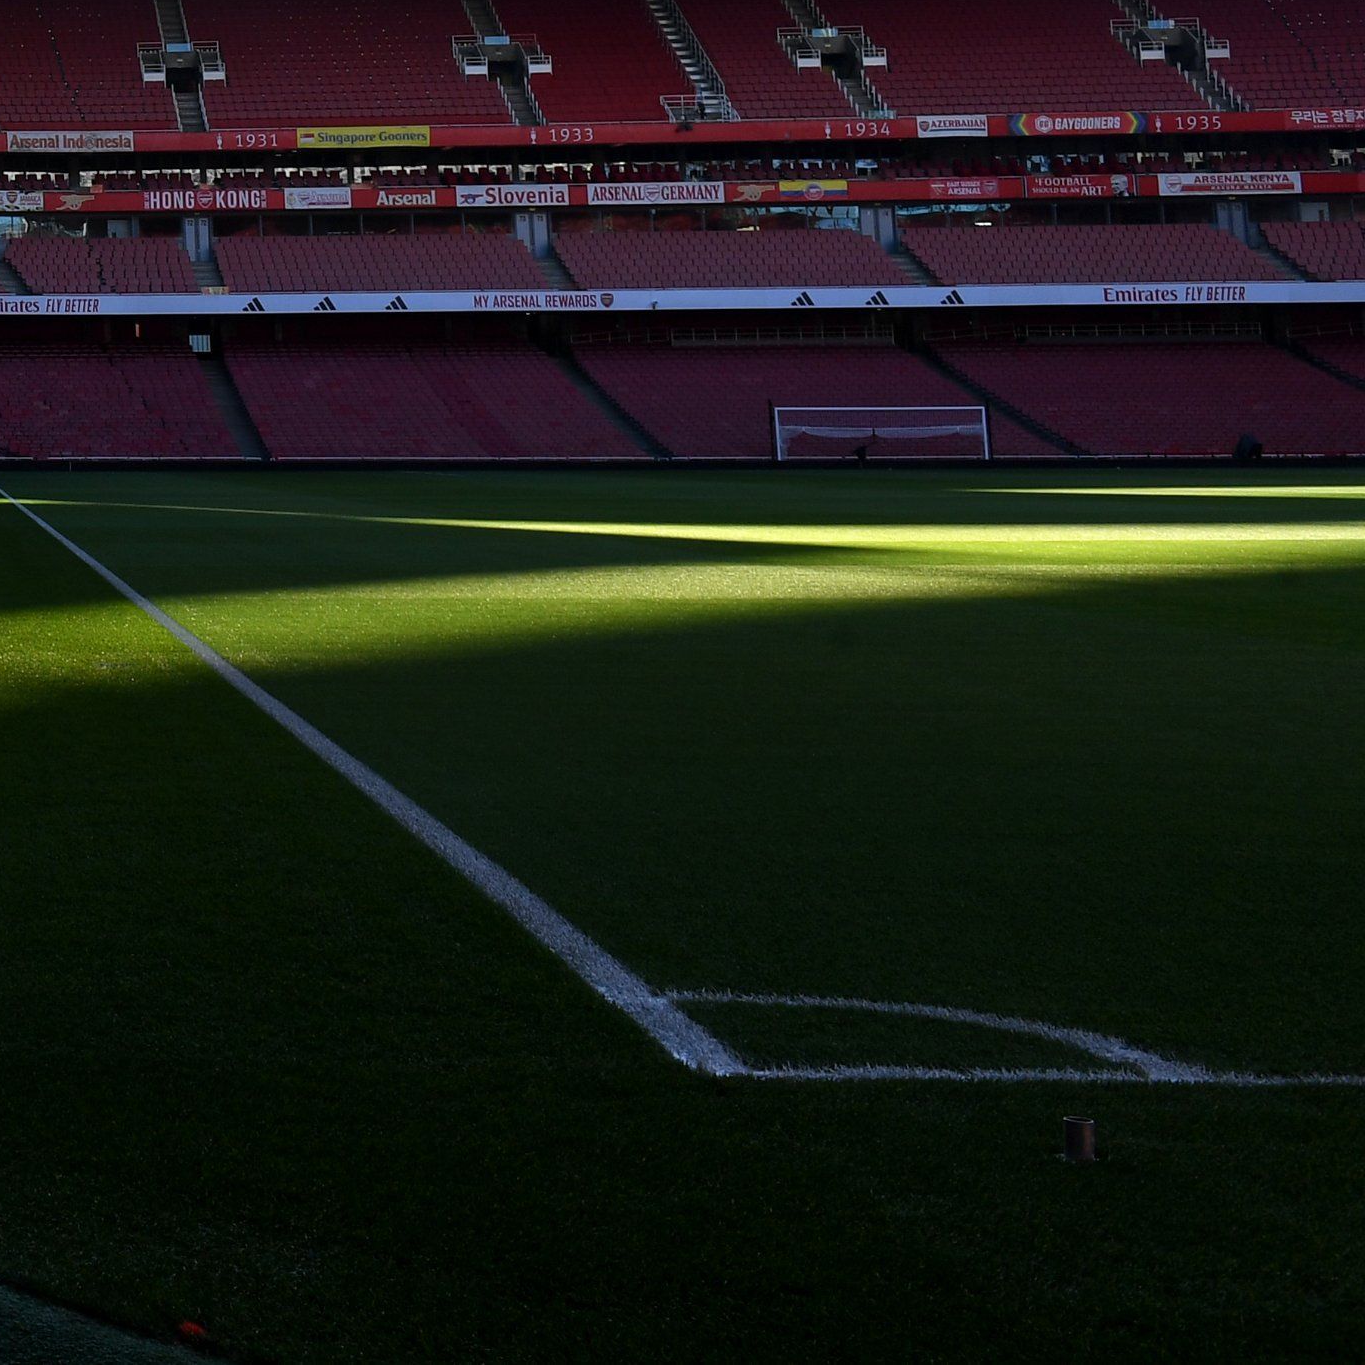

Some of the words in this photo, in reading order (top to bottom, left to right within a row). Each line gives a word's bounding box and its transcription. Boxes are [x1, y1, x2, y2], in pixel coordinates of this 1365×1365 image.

[845, 122, 891, 136] 1934
[930, 119, 986, 128] AZERBAIJAN
[1055, 116, 1121, 130] GAYGOONERS
[1176, 116, 1222, 130] 1935
[10, 134, 59, 149] Arsenal
[235, 134, 278, 147] 1931
[317, 132, 375, 144] Singapore
[379, 131, 427, 141] Gooners
[549, 128, 594, 142] 1933
[1194, 175, 1246, 184] ARSENAL
[1250, 174, 1289, 182] KENYA
[376, 190, 436, 206] Arsenal
[485, 186, 565, 204] Slovenia
[591, 185, 645, 201] ARSENAL
[661, 184, 720, 201] GERMANY
[948, 187, 981, 195] ARSENAL
[150, 191, 195, 209] HONG
[216, 190, 261, 209] KONG
[1103, 287, 1178, 302] Emirates
[1185, 287, 1202, 301] FLY
[1206, 286, 1245, 301] BETTER
[46, 299, 64, 312] FLY
[65, 299, 99, 313] BETTER
[474, 295, 491, 308] MY
[493, 295, 541, 308] ARSENAL
[545, 295, 597, 308] REWARDS
